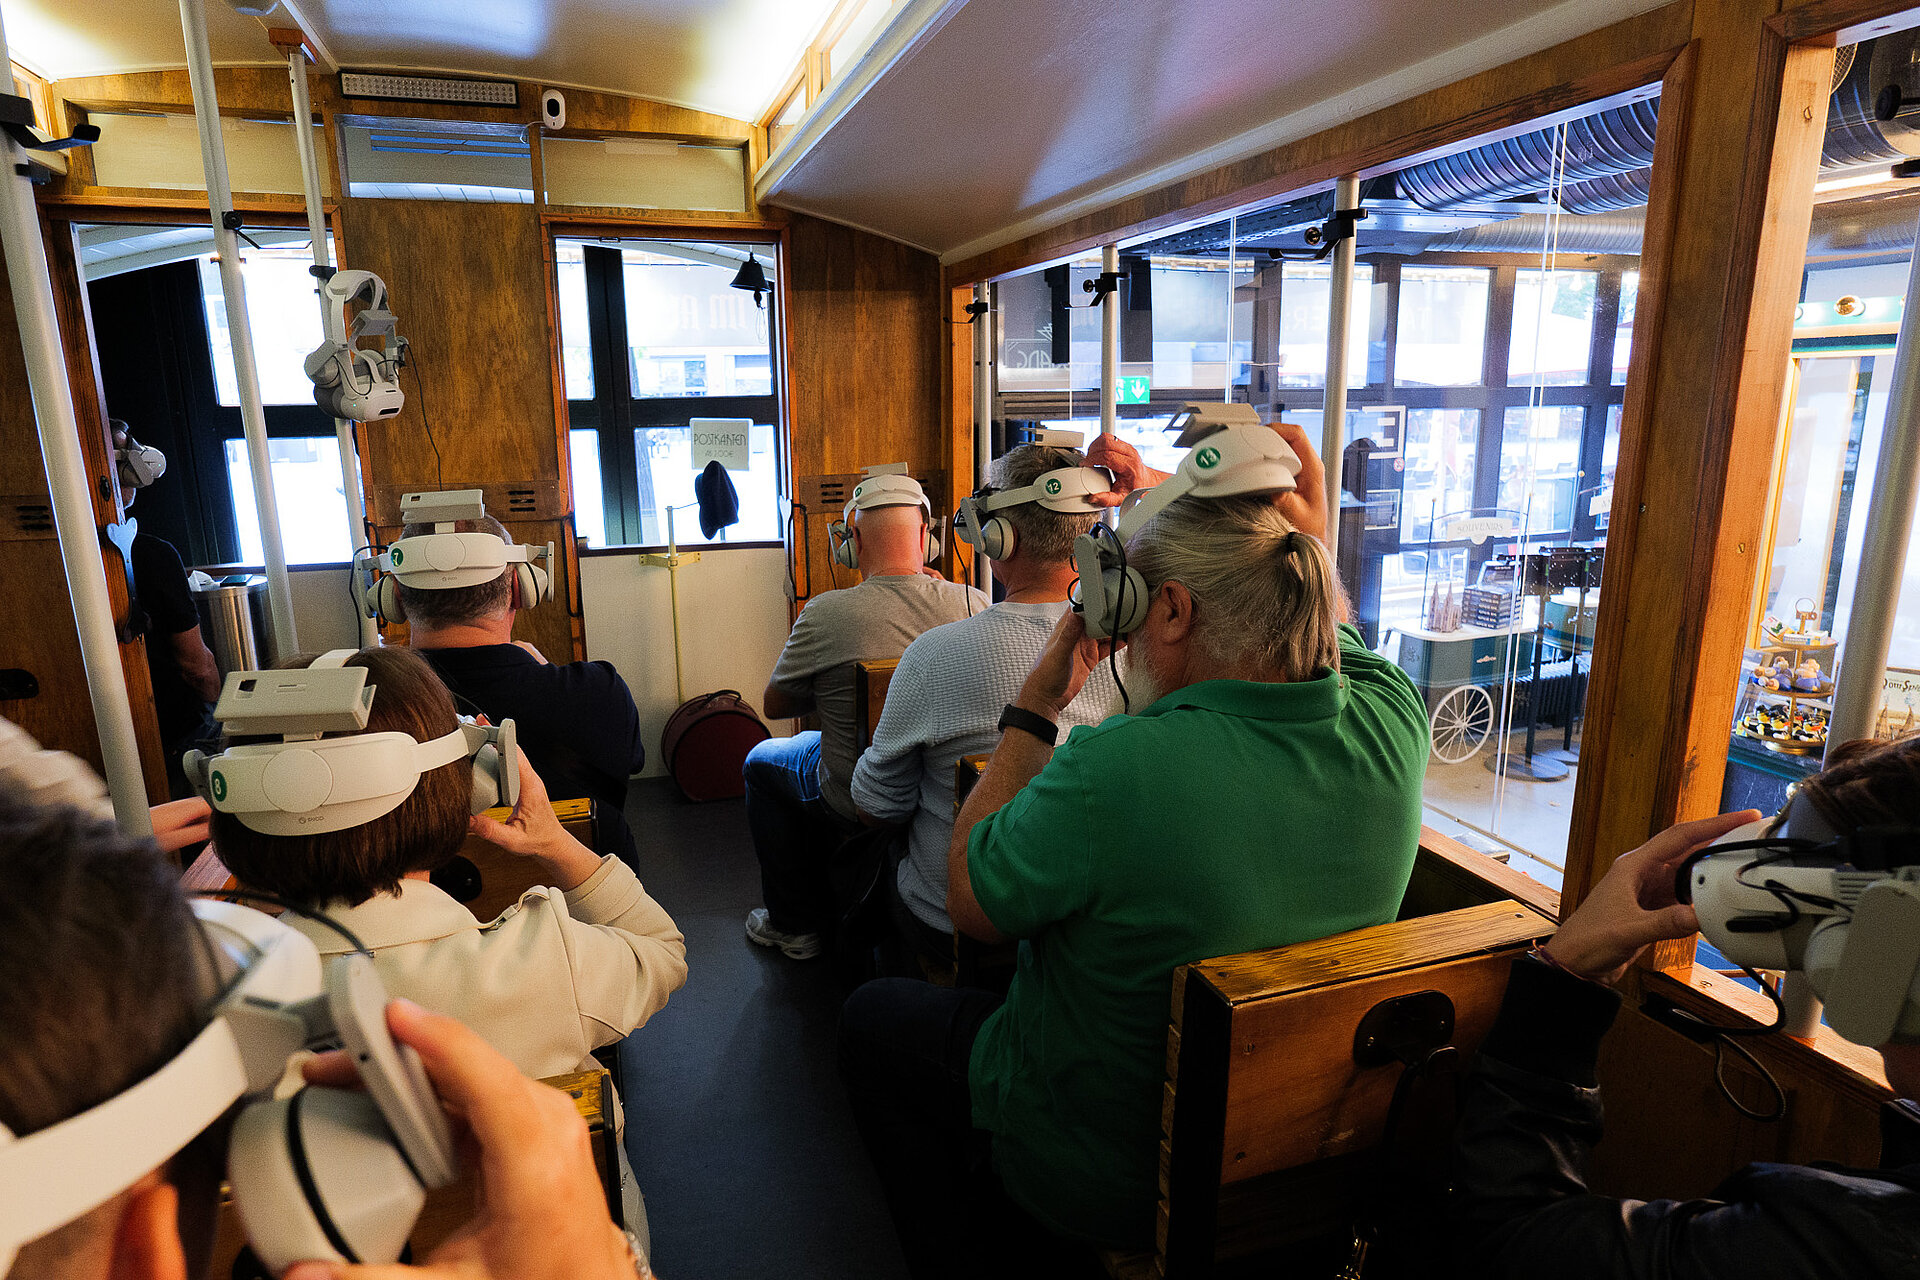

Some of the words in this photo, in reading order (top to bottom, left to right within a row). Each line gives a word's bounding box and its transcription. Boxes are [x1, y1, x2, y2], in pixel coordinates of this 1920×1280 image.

[693, 433, 746, 446] POSTKARTEN
[1200, 448, 1218, 466] 13
[1047, 482, 1060, 492] 12
[1457, 520, 1504, 534] SOUVENIRS
[214, 778, 221, 795] 8
